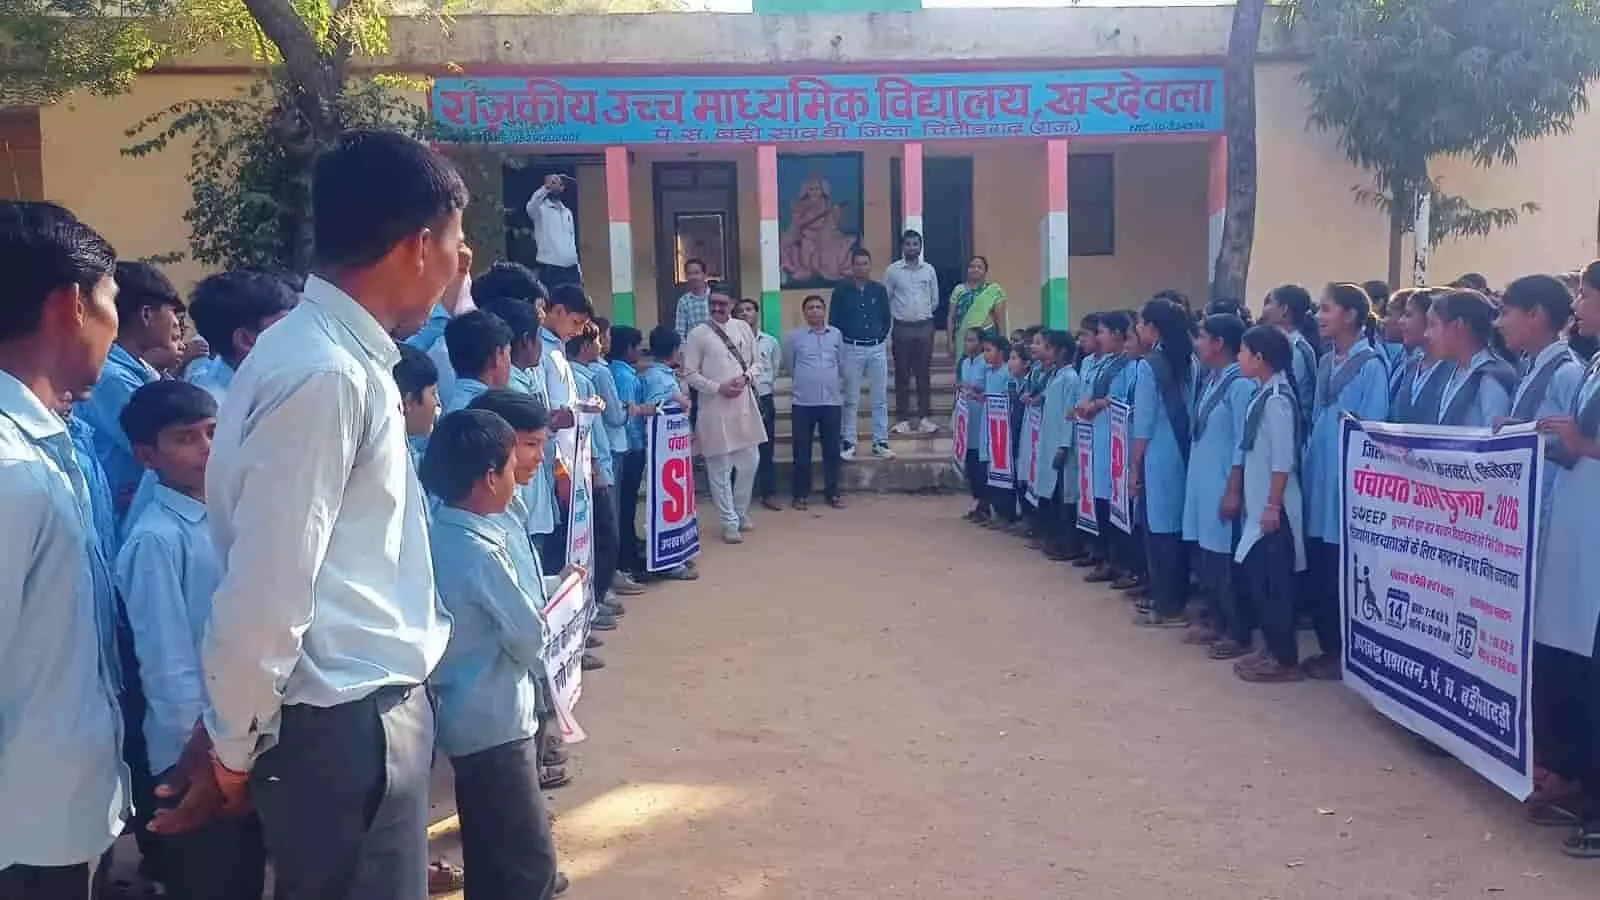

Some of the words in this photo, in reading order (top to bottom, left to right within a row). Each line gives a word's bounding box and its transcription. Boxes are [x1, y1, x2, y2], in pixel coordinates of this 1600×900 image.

[439, 79, 598, 129] राजकीय
[603, 88, 686, 125] उच्च
[691, 76, 869, 125] माध्यमिक
[1045, 71, 1216, 119] खरदेवला
[1353, 464, 1410, 503] पंचायत
[1494, 493, 1520, 530] 2026
[1388, 600, 1403, 621] 14
[1458, 627, 1473, 649] 16
